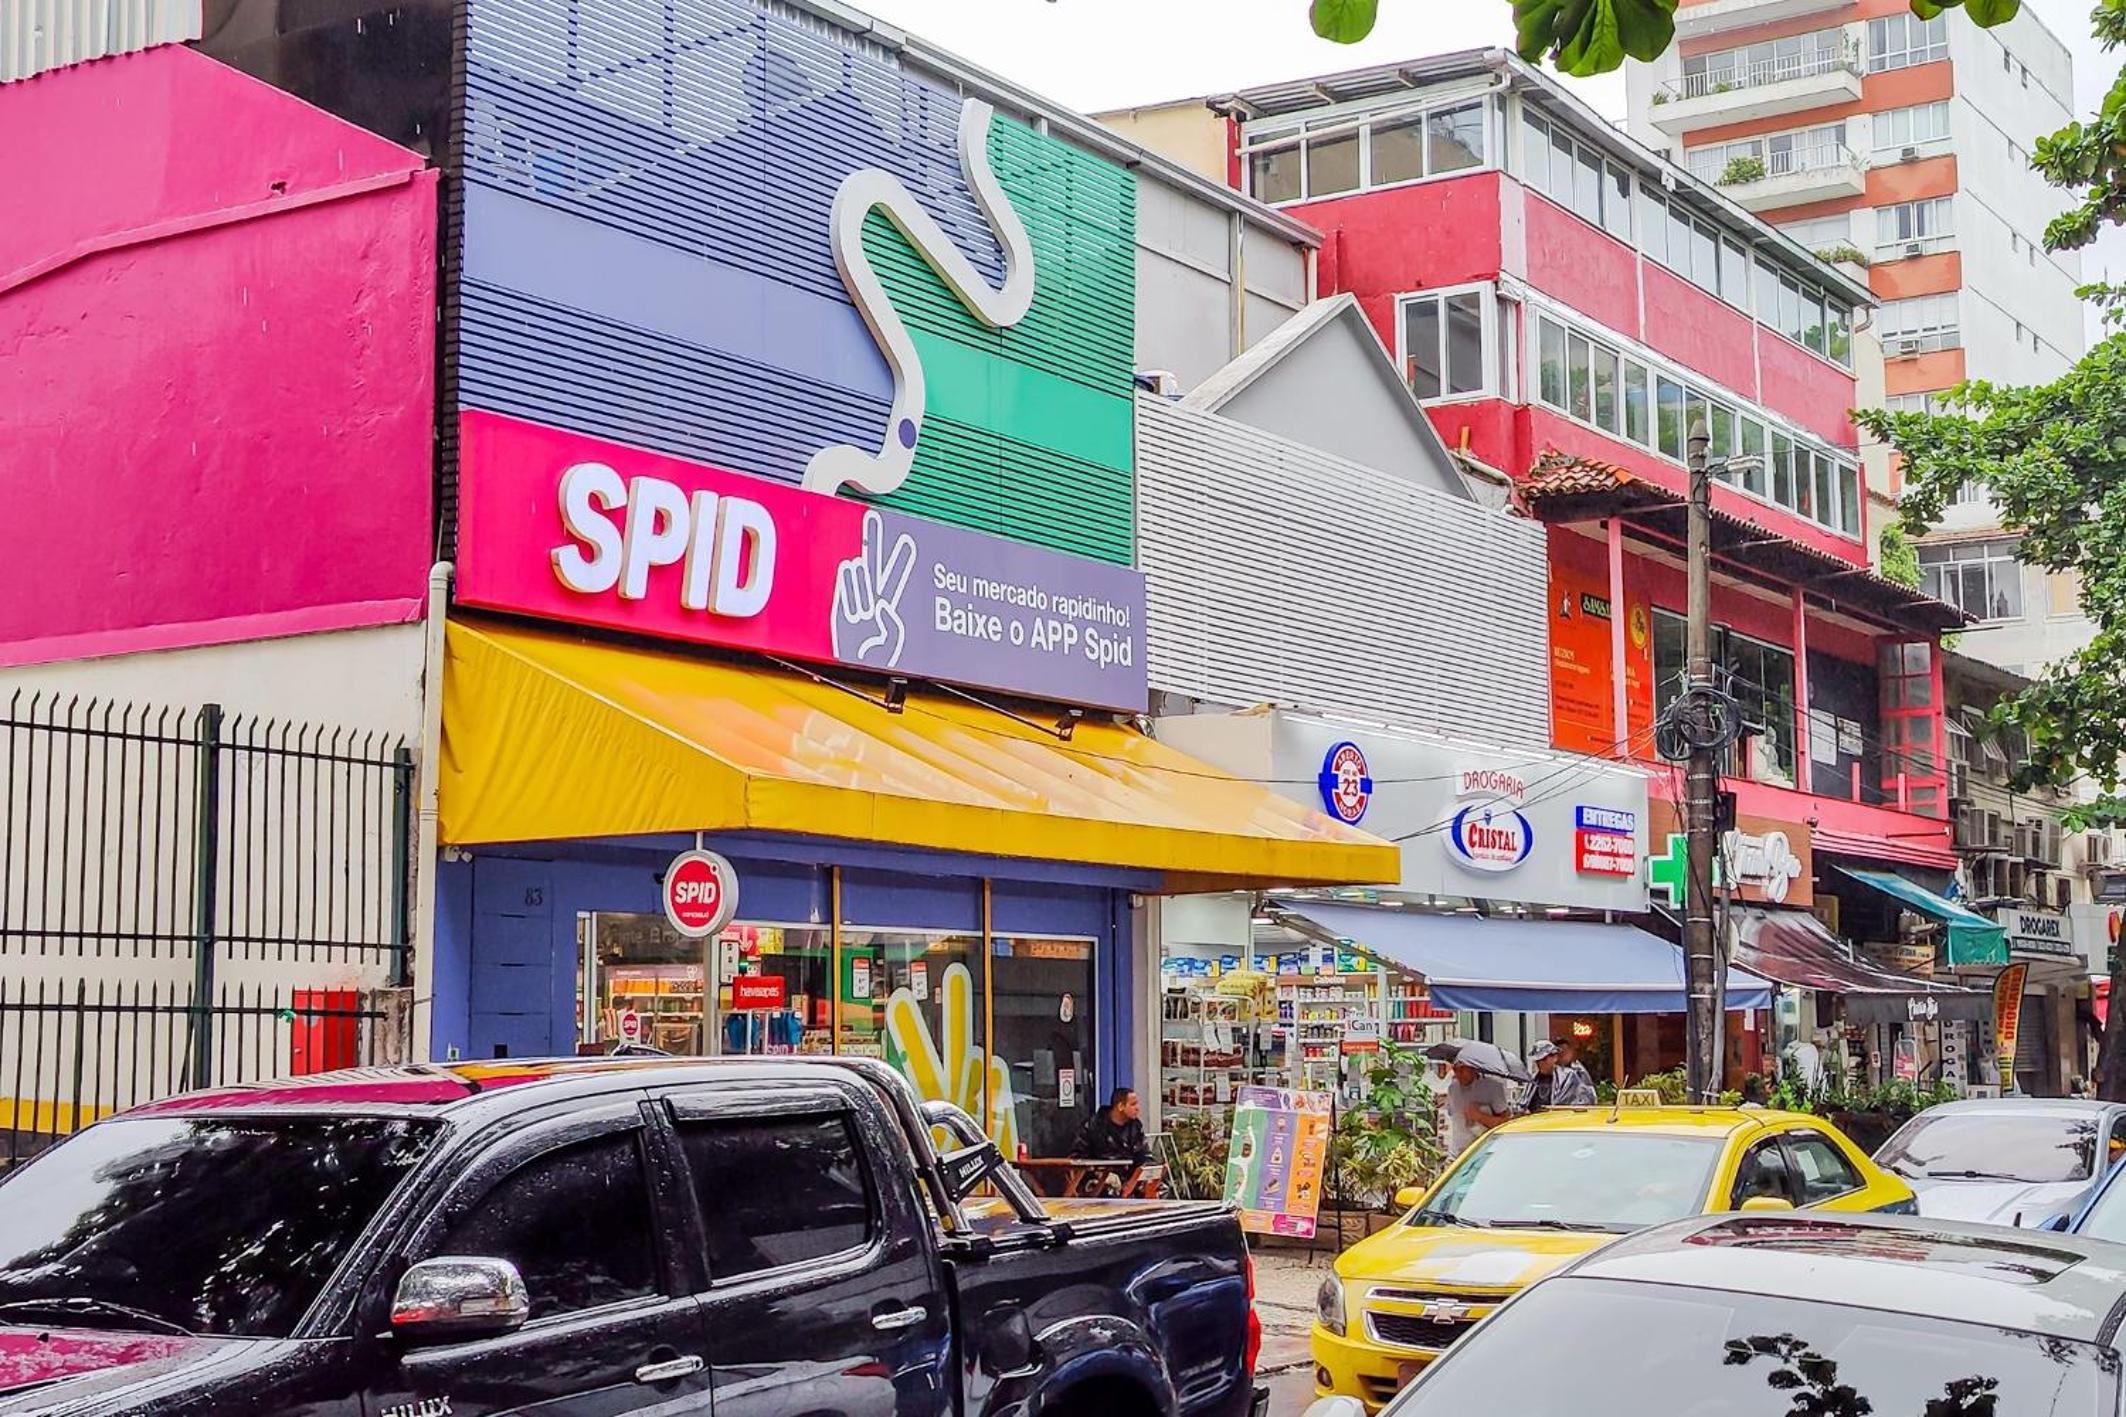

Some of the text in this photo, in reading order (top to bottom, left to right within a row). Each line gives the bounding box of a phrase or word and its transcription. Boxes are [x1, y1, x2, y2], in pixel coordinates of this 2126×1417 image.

[551, 462, 777, 618] SPID
[933, 562, 1131, 628] Seu mercado rapidinho!
[935, 596, 1132, 669] Baixe o APP Spid
[1343, 778, 1358, 797] 23
[1463, 770, 1524, 800] DROGARIA
[1583, 807, 1633, 831] ENTREGAS
[1468, 822, 1517, 852] CRISTAL
[525, 887, 543, 907] 83
[674, 881, 717, 904] SPID
[2020, 915, 2060, 938] DROGAREX
[1622, 1092, 1655, 1107] TAXI
[958, 1154, 984, 1178] HILUX
